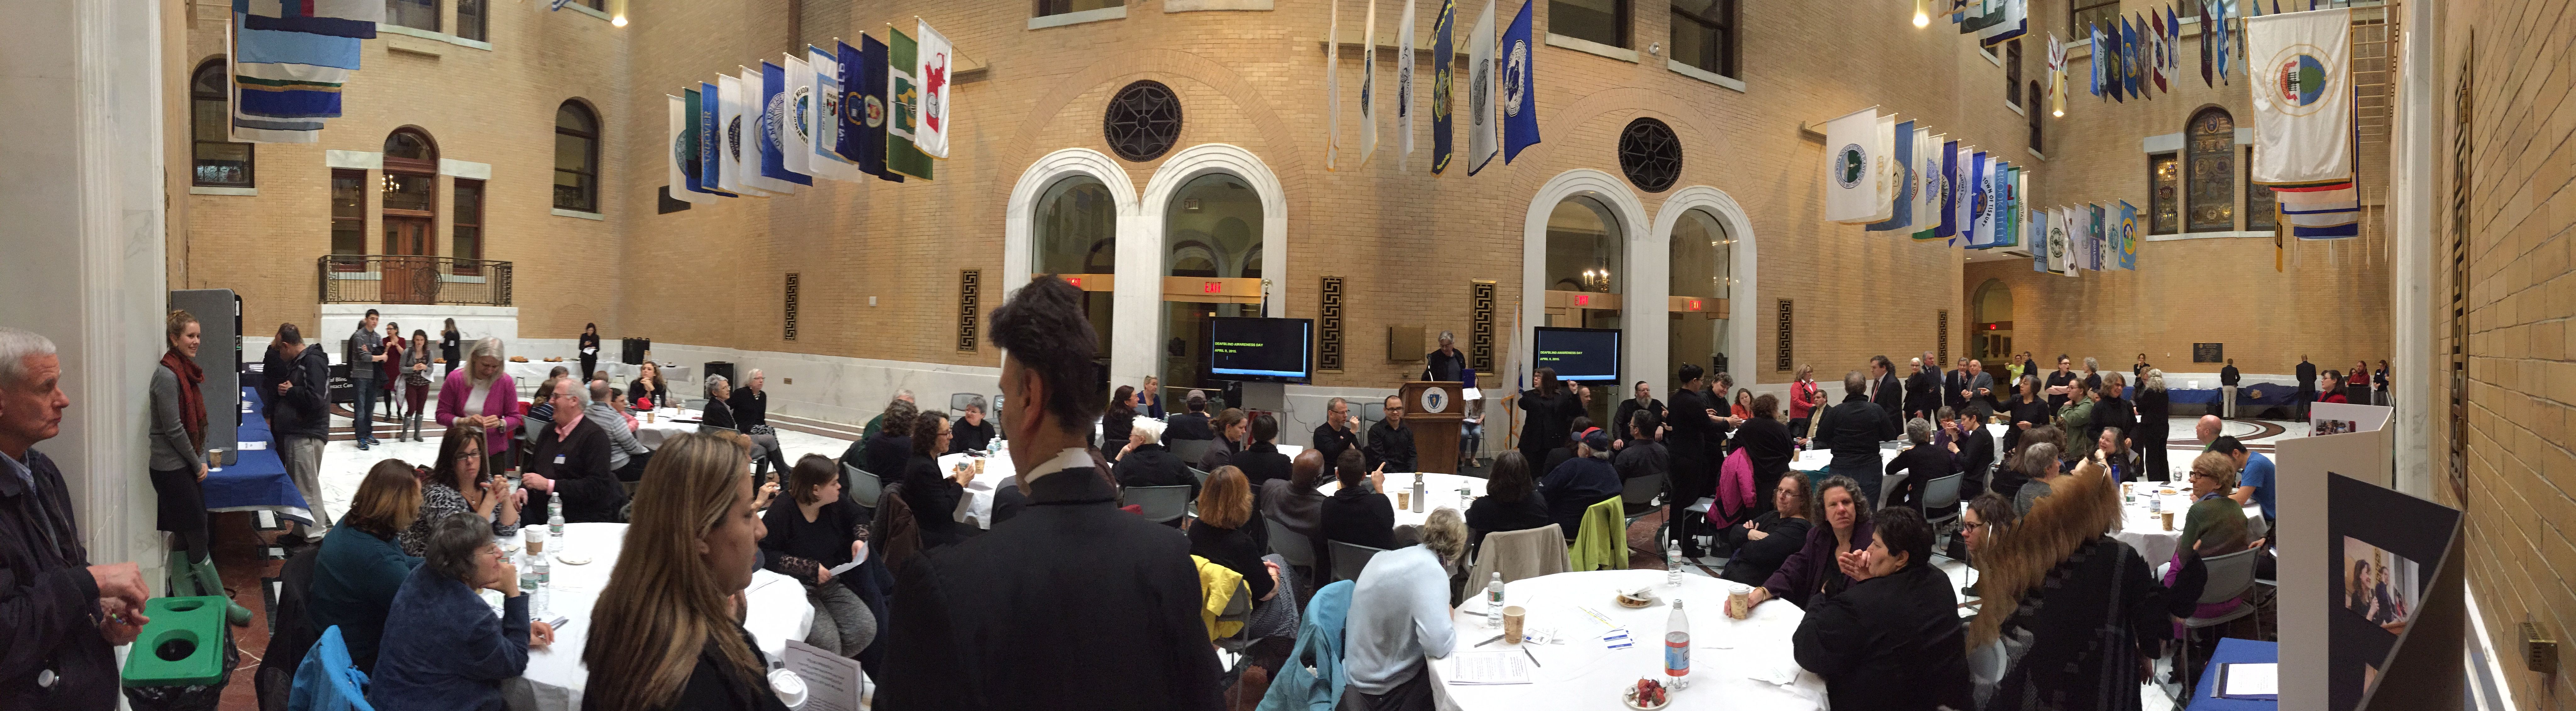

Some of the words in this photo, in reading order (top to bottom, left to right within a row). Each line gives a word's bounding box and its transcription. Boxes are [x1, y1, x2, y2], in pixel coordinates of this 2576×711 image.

[1983, 177, 1993, 193] TOWN
[1981, 204, 1993, 227] TISBURY
[1205, 282, 1221, 293] EXIT
[1574, 295, 1589, 306] EXIT
[1690, 300, 1702, 311] EXIT
